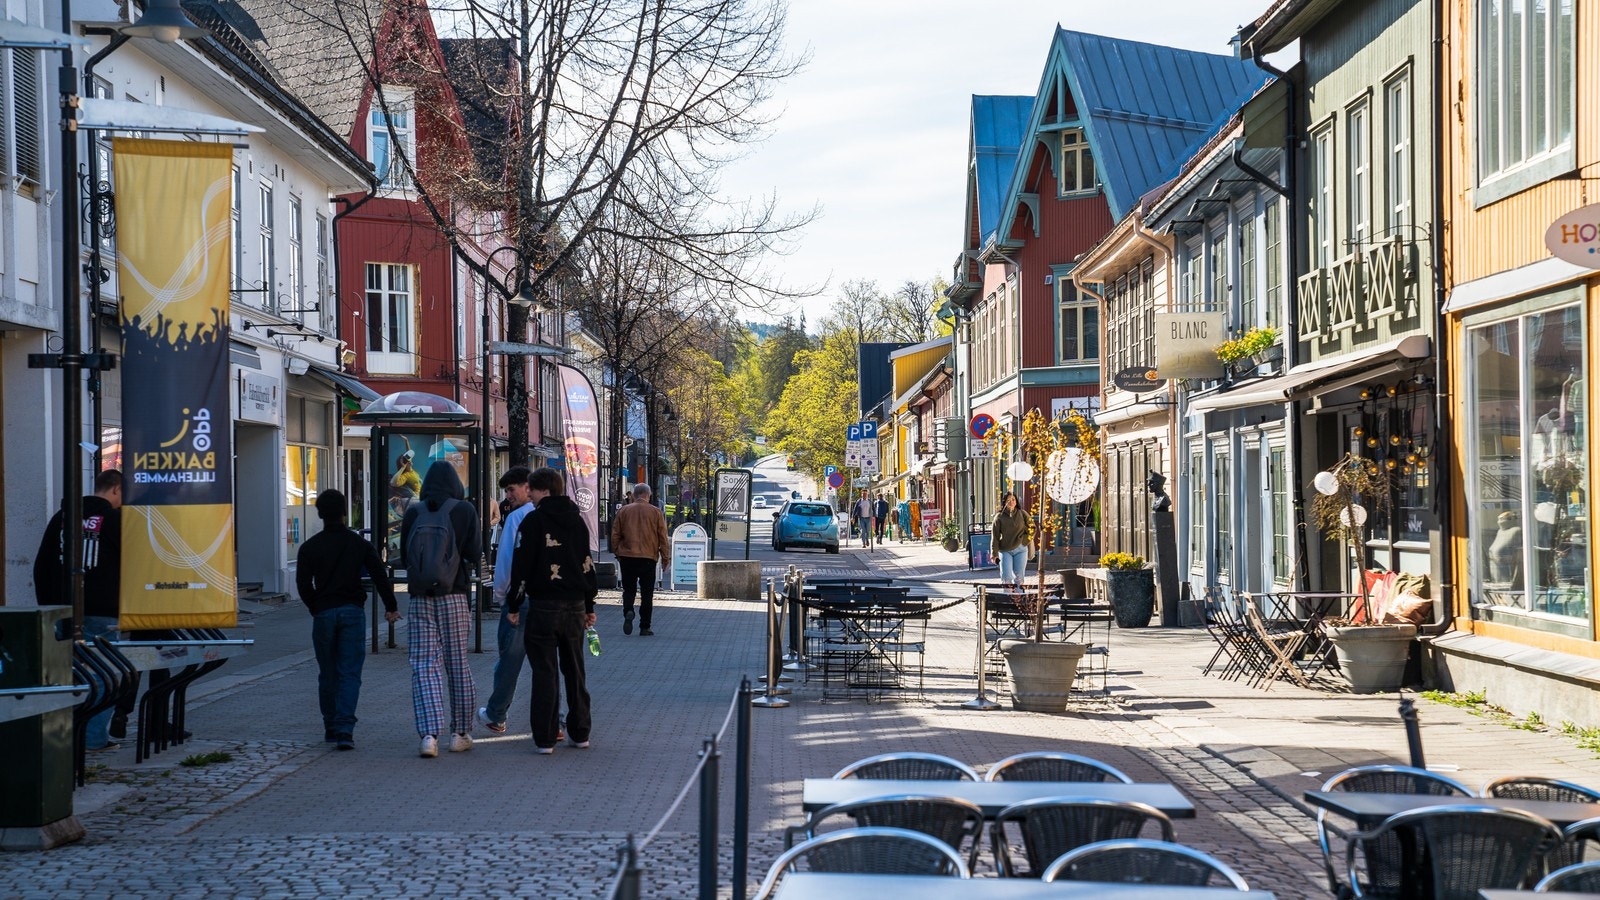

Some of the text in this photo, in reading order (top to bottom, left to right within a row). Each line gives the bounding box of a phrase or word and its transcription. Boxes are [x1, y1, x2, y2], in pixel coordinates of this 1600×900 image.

[1561, 223, 1600, 244] HO
[1171, 321, 1207, 339] BLANC
[863, 423, 873, 437] P
[723, 475, 740, 484] Son
